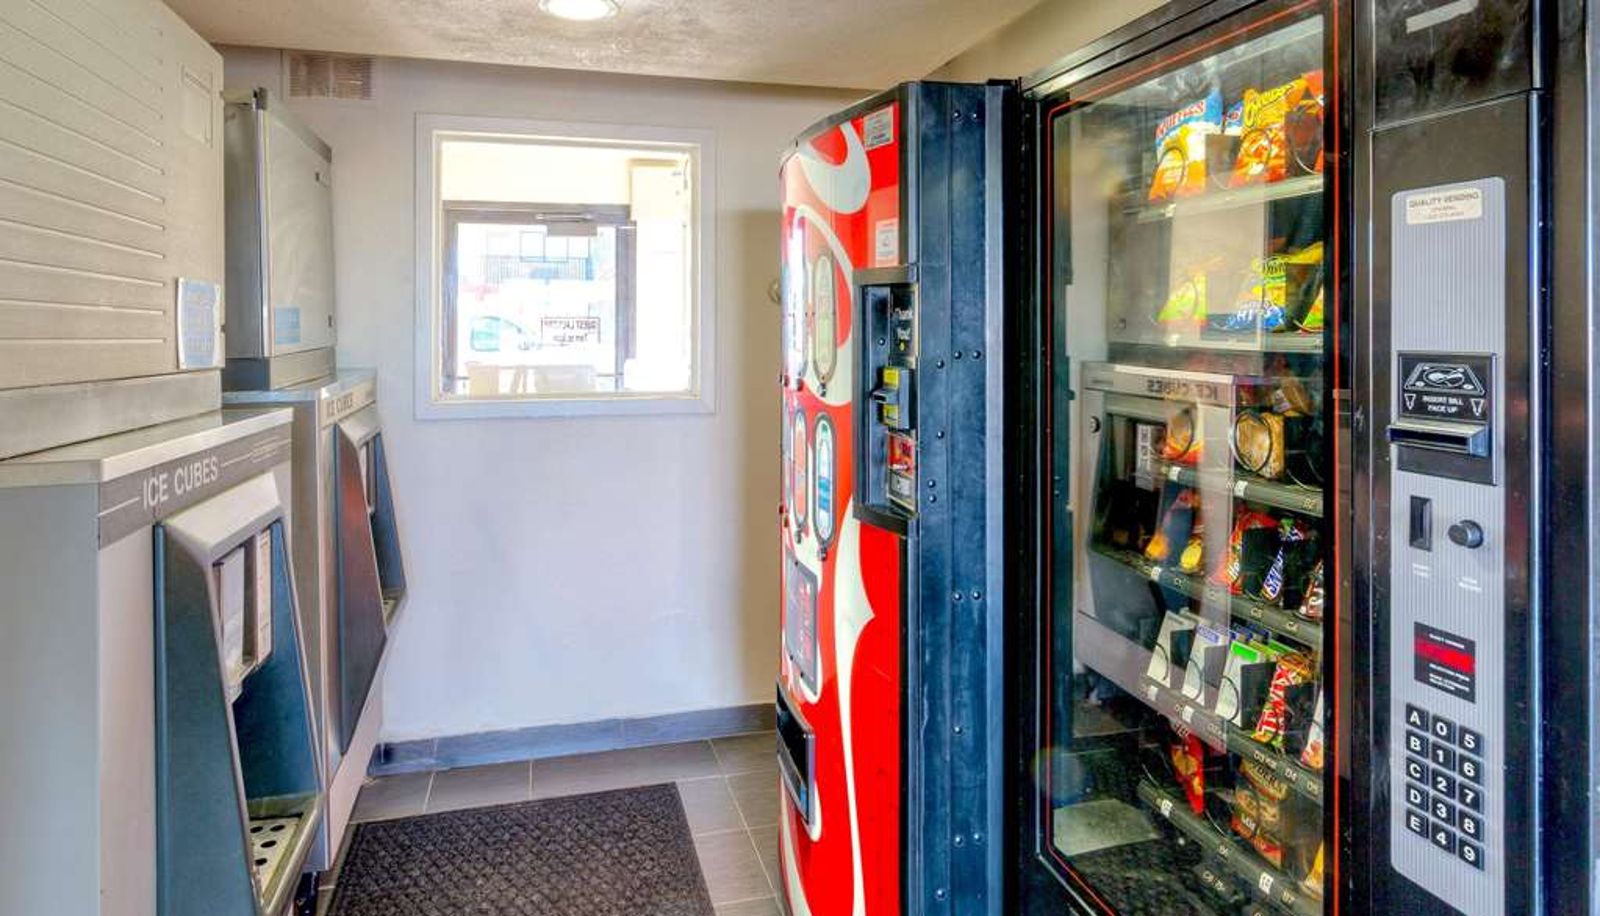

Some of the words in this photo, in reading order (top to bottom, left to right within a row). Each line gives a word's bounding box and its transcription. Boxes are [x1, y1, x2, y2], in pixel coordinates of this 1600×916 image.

[143, 473, 169, 511] ICE
[174, 456, 219, 496] CUBES
[1410, 711, 1421, 725] A
[1436, 722, 1447, 736] 0
[1410, 736, 1421, 751] B
[1463, 734, 1475, 748] 5
[1436, 750, 1444, 763] 1
[1410, 763, 1421, 778] C
[1463, 762, 1475, 777] 6
[1436, 777, 1447, 792] 2
[1410, 789, 1421, 803] D
[1463, 789, 1475, 803] 7
[1436, 803, 1447, 818] 3
[1410, 815, 1421, 832] E
[1463, 818, 1475, 834] 8
[1436, 831, 1446, 845] 4
[1463, 846, 1475, 861] 9
